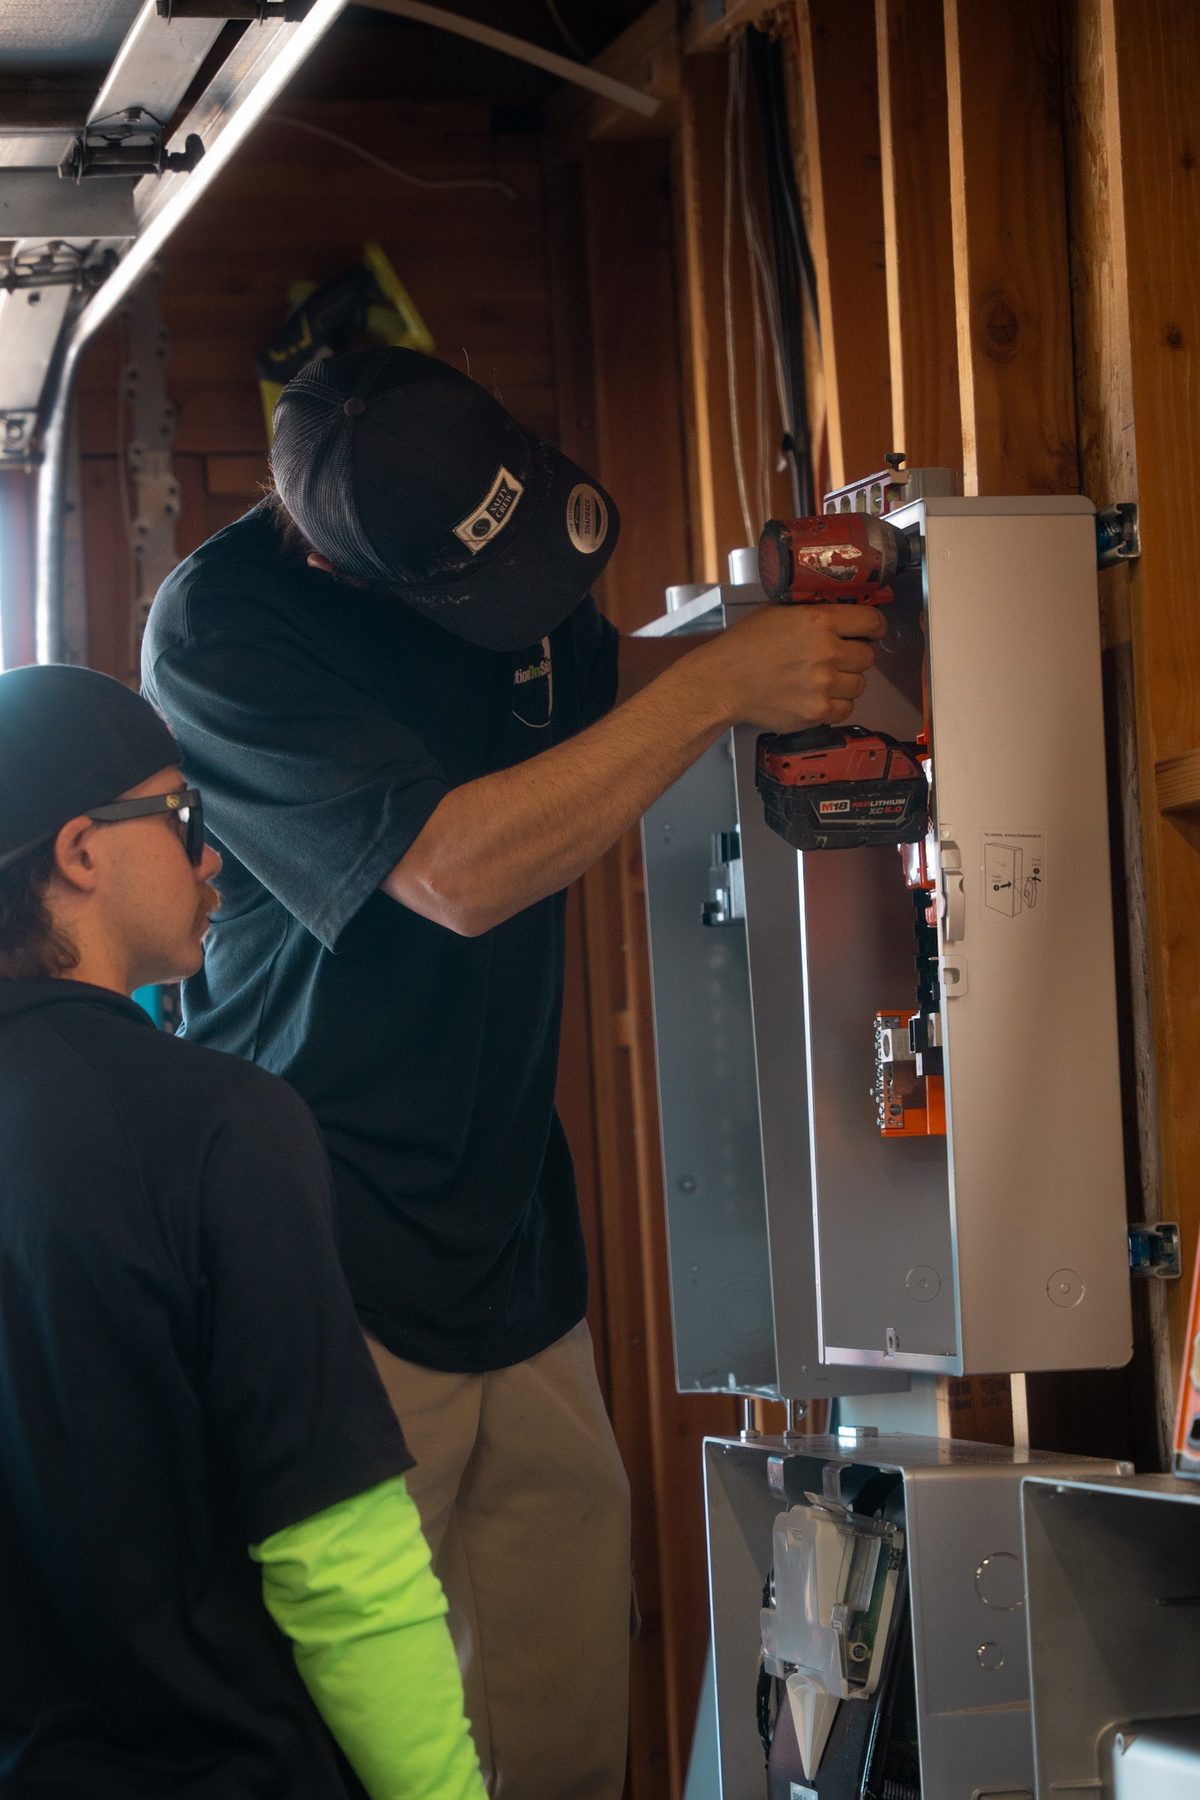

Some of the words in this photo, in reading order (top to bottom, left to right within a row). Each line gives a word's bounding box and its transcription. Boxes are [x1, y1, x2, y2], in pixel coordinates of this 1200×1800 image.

[490, 488, 507, 512] SALTY
[496, 495, 513, 518] CREW
[822, 802, 848, 812] M18
[852, 799, 906, 808] REDLITHIUM
